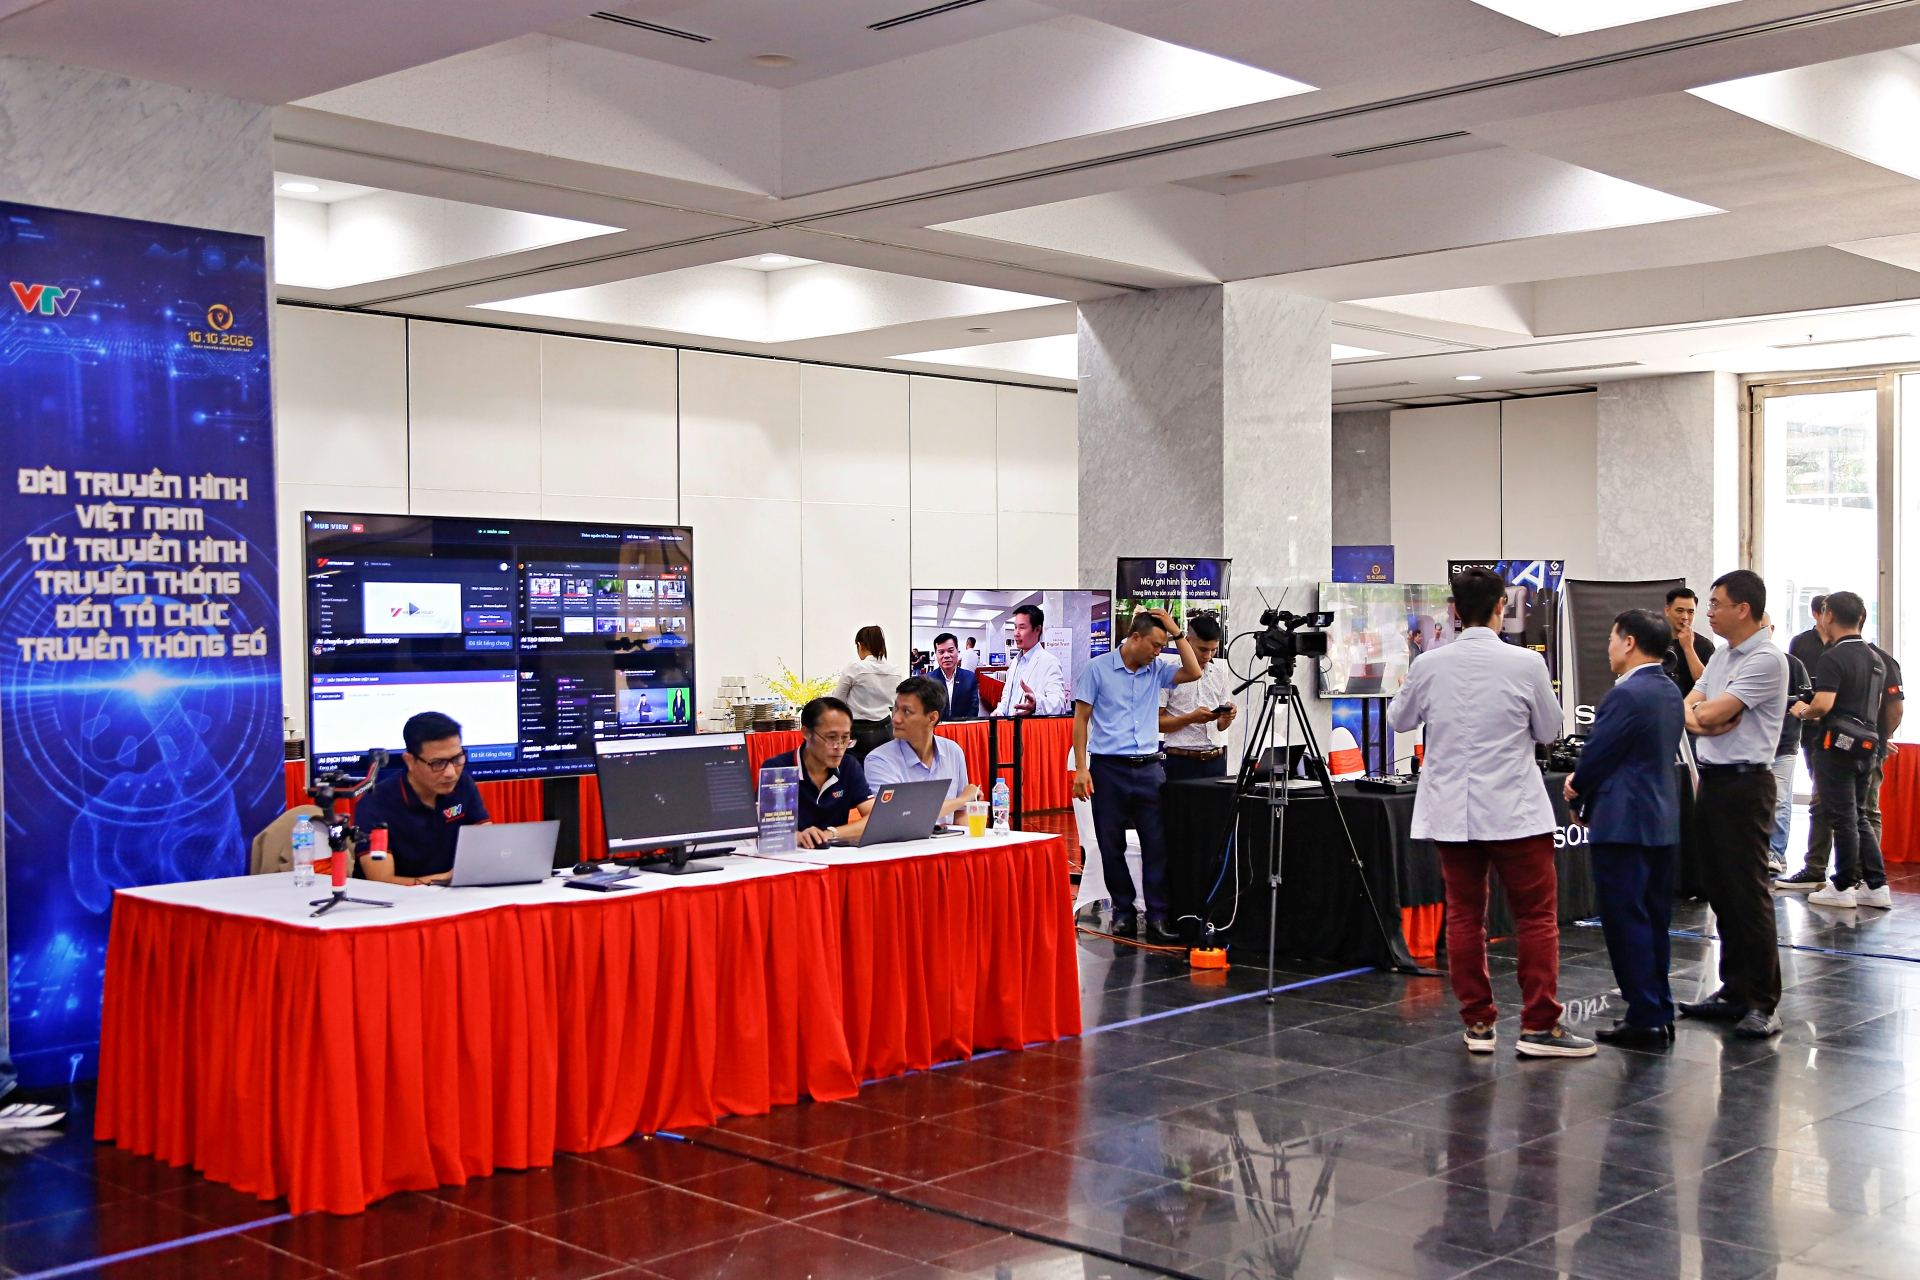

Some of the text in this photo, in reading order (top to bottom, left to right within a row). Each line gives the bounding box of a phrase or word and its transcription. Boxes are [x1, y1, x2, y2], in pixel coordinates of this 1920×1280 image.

[10, 281, 81, 316] VTV
[188, 330, 254, 347] 10.10.2026
[18, 465, 248, 500] ĐÀI TRUYỀN HÌNH
[76, 501, 204, 532] VIỆT NAM
[26, 532, 248, 562] TỪ TRUYỀN HÌNH
[35, 564, 240, 594] TRUYỀN THỐNG
[1141, 578, 1154, 586] Máy
[1156, 578, 1165, 587] ghi
[1167, 577, 1180, 586] hình
[56, 596, 230, 628] ĐẾN TỔ CHỨC
[17, 626, 267, 662] TRUYỀN THÔNG SỐ
[341, 755, 361, 763] THUẬT
[444, 804, 462, 818] VTV
